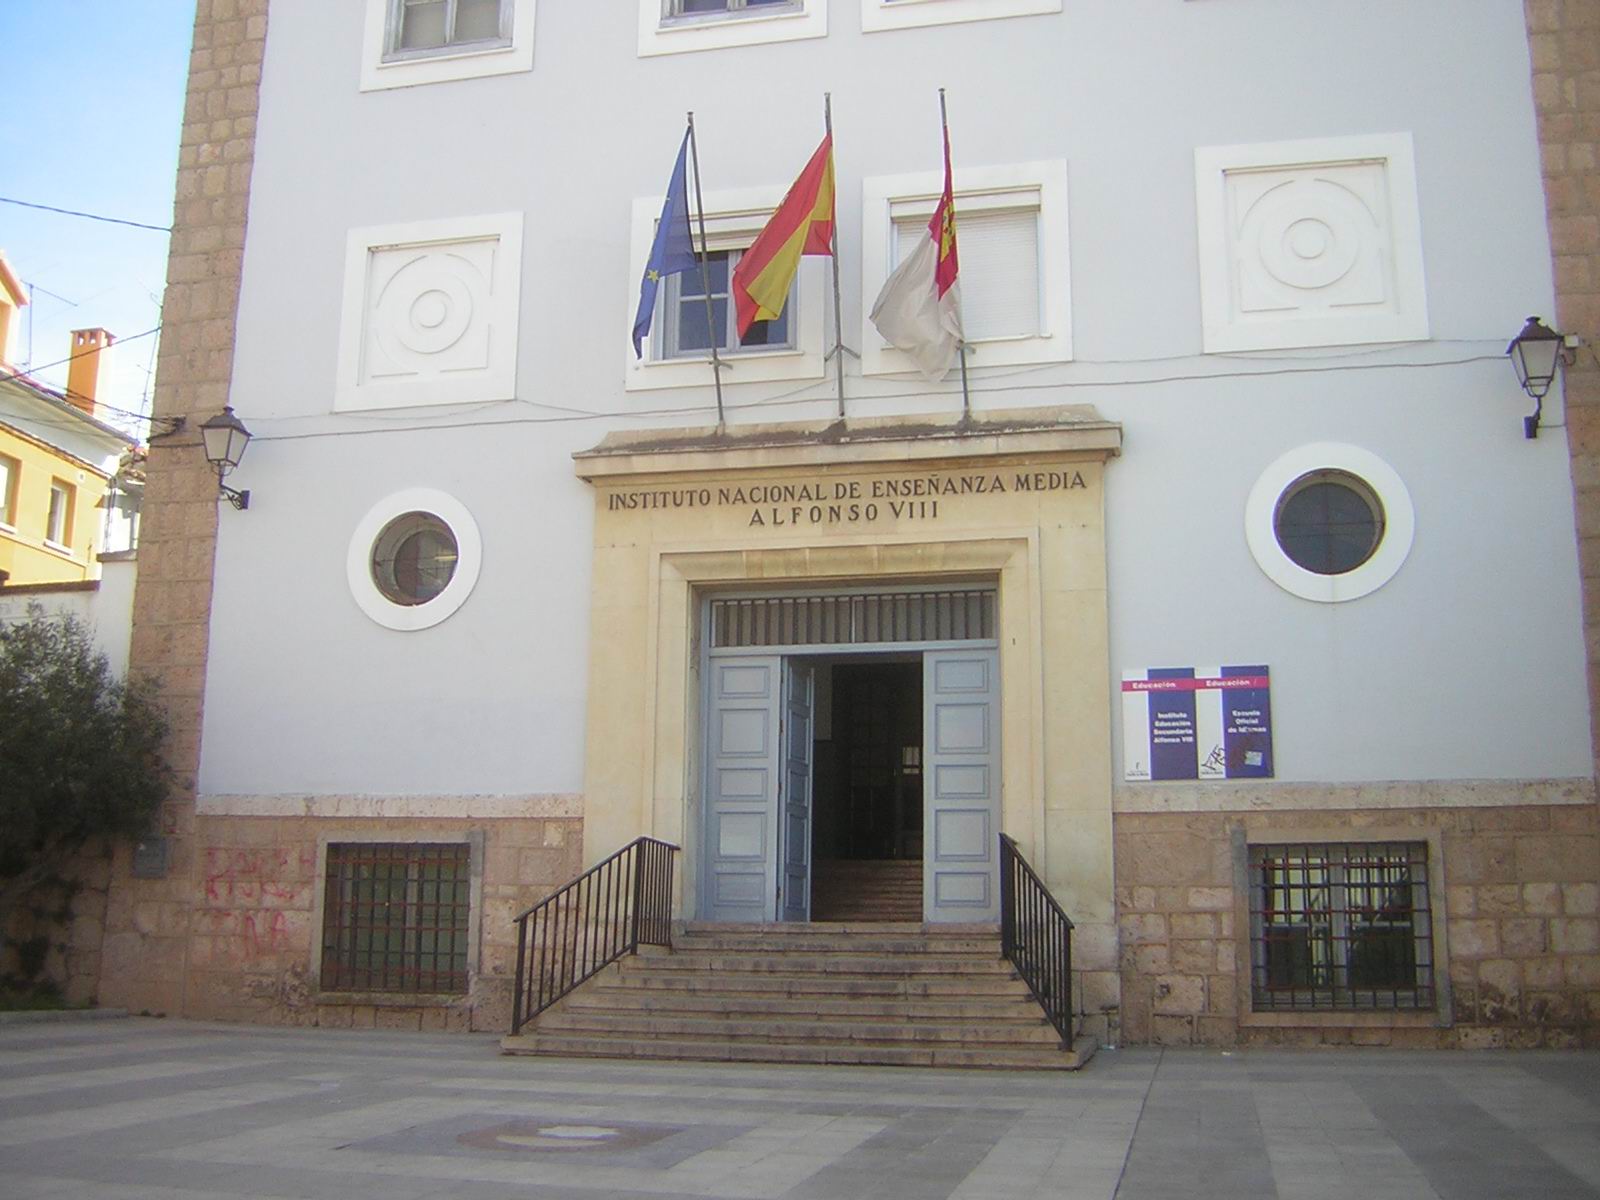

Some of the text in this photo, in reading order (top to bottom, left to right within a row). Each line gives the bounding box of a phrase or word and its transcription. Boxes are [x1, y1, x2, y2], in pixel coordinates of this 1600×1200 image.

[608, 470, 1087, 511] INSTITUTO NACIONAL DE ENSEÑANZA MEDIA
[749, 500, 939, 527] ALFONSO VIII
[1132, 681, 1177, 690] Educación
[1205, 679, 1251, 688] Educación
